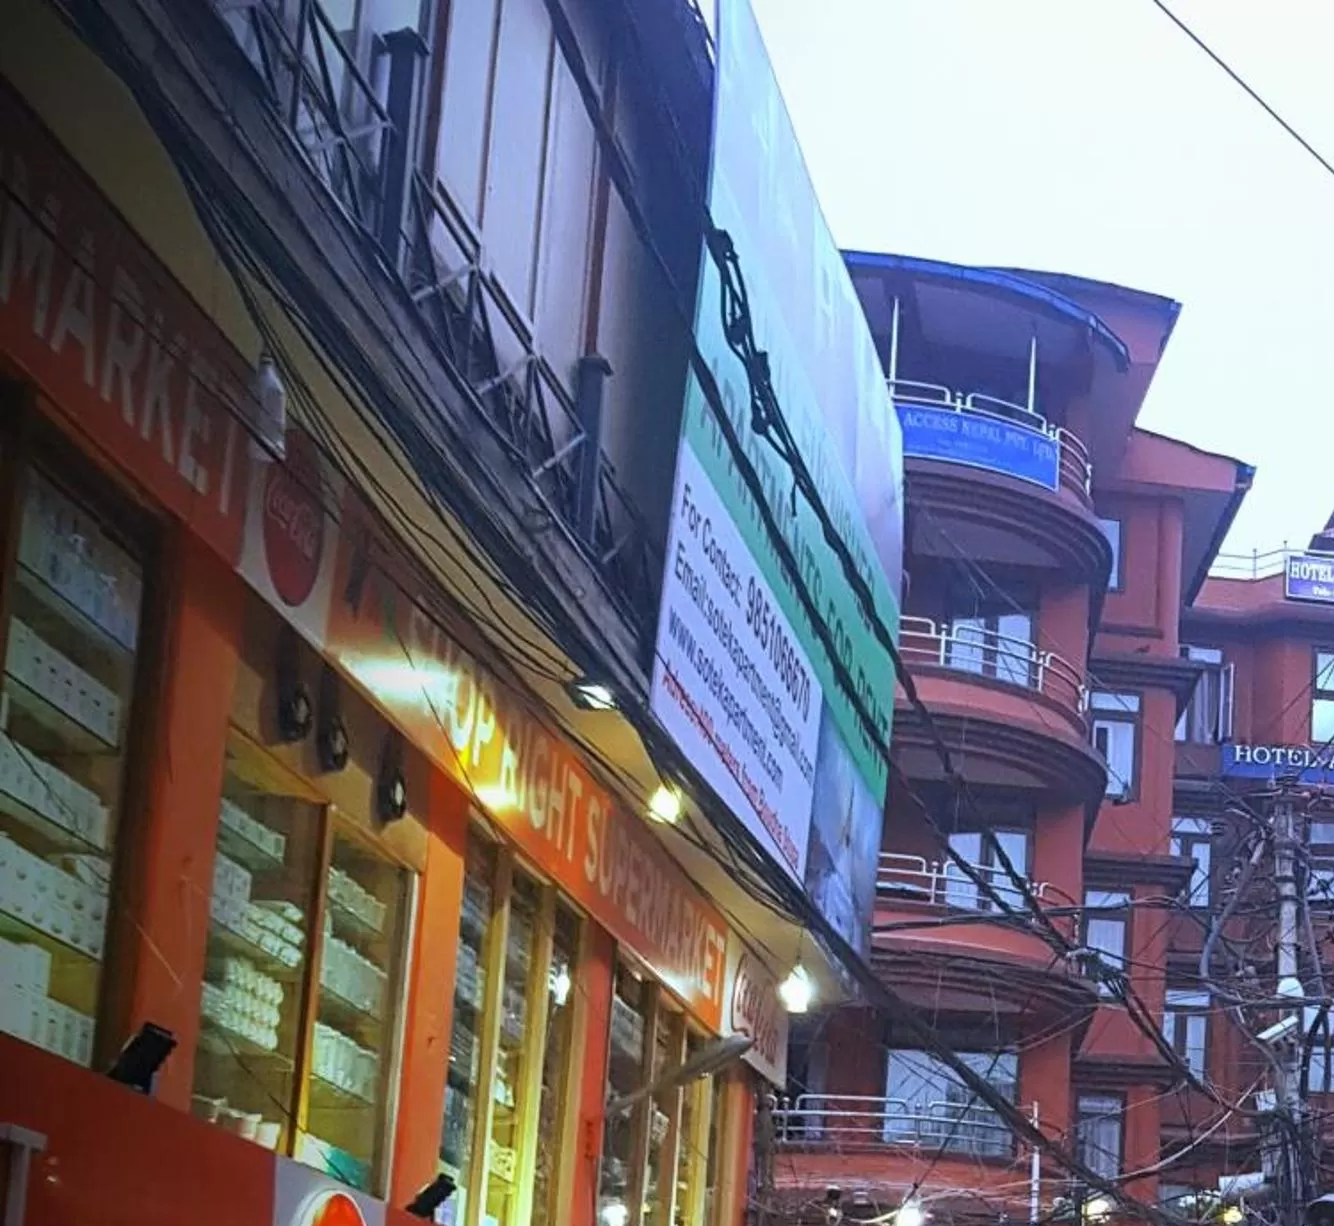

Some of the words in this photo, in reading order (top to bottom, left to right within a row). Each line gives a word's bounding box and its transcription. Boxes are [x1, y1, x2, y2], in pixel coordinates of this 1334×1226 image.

[680, 481, 702, 538] For
[1290, 560, 1334, 582] HOTEL
[1234, 745, 1318, 768] HOTEL
